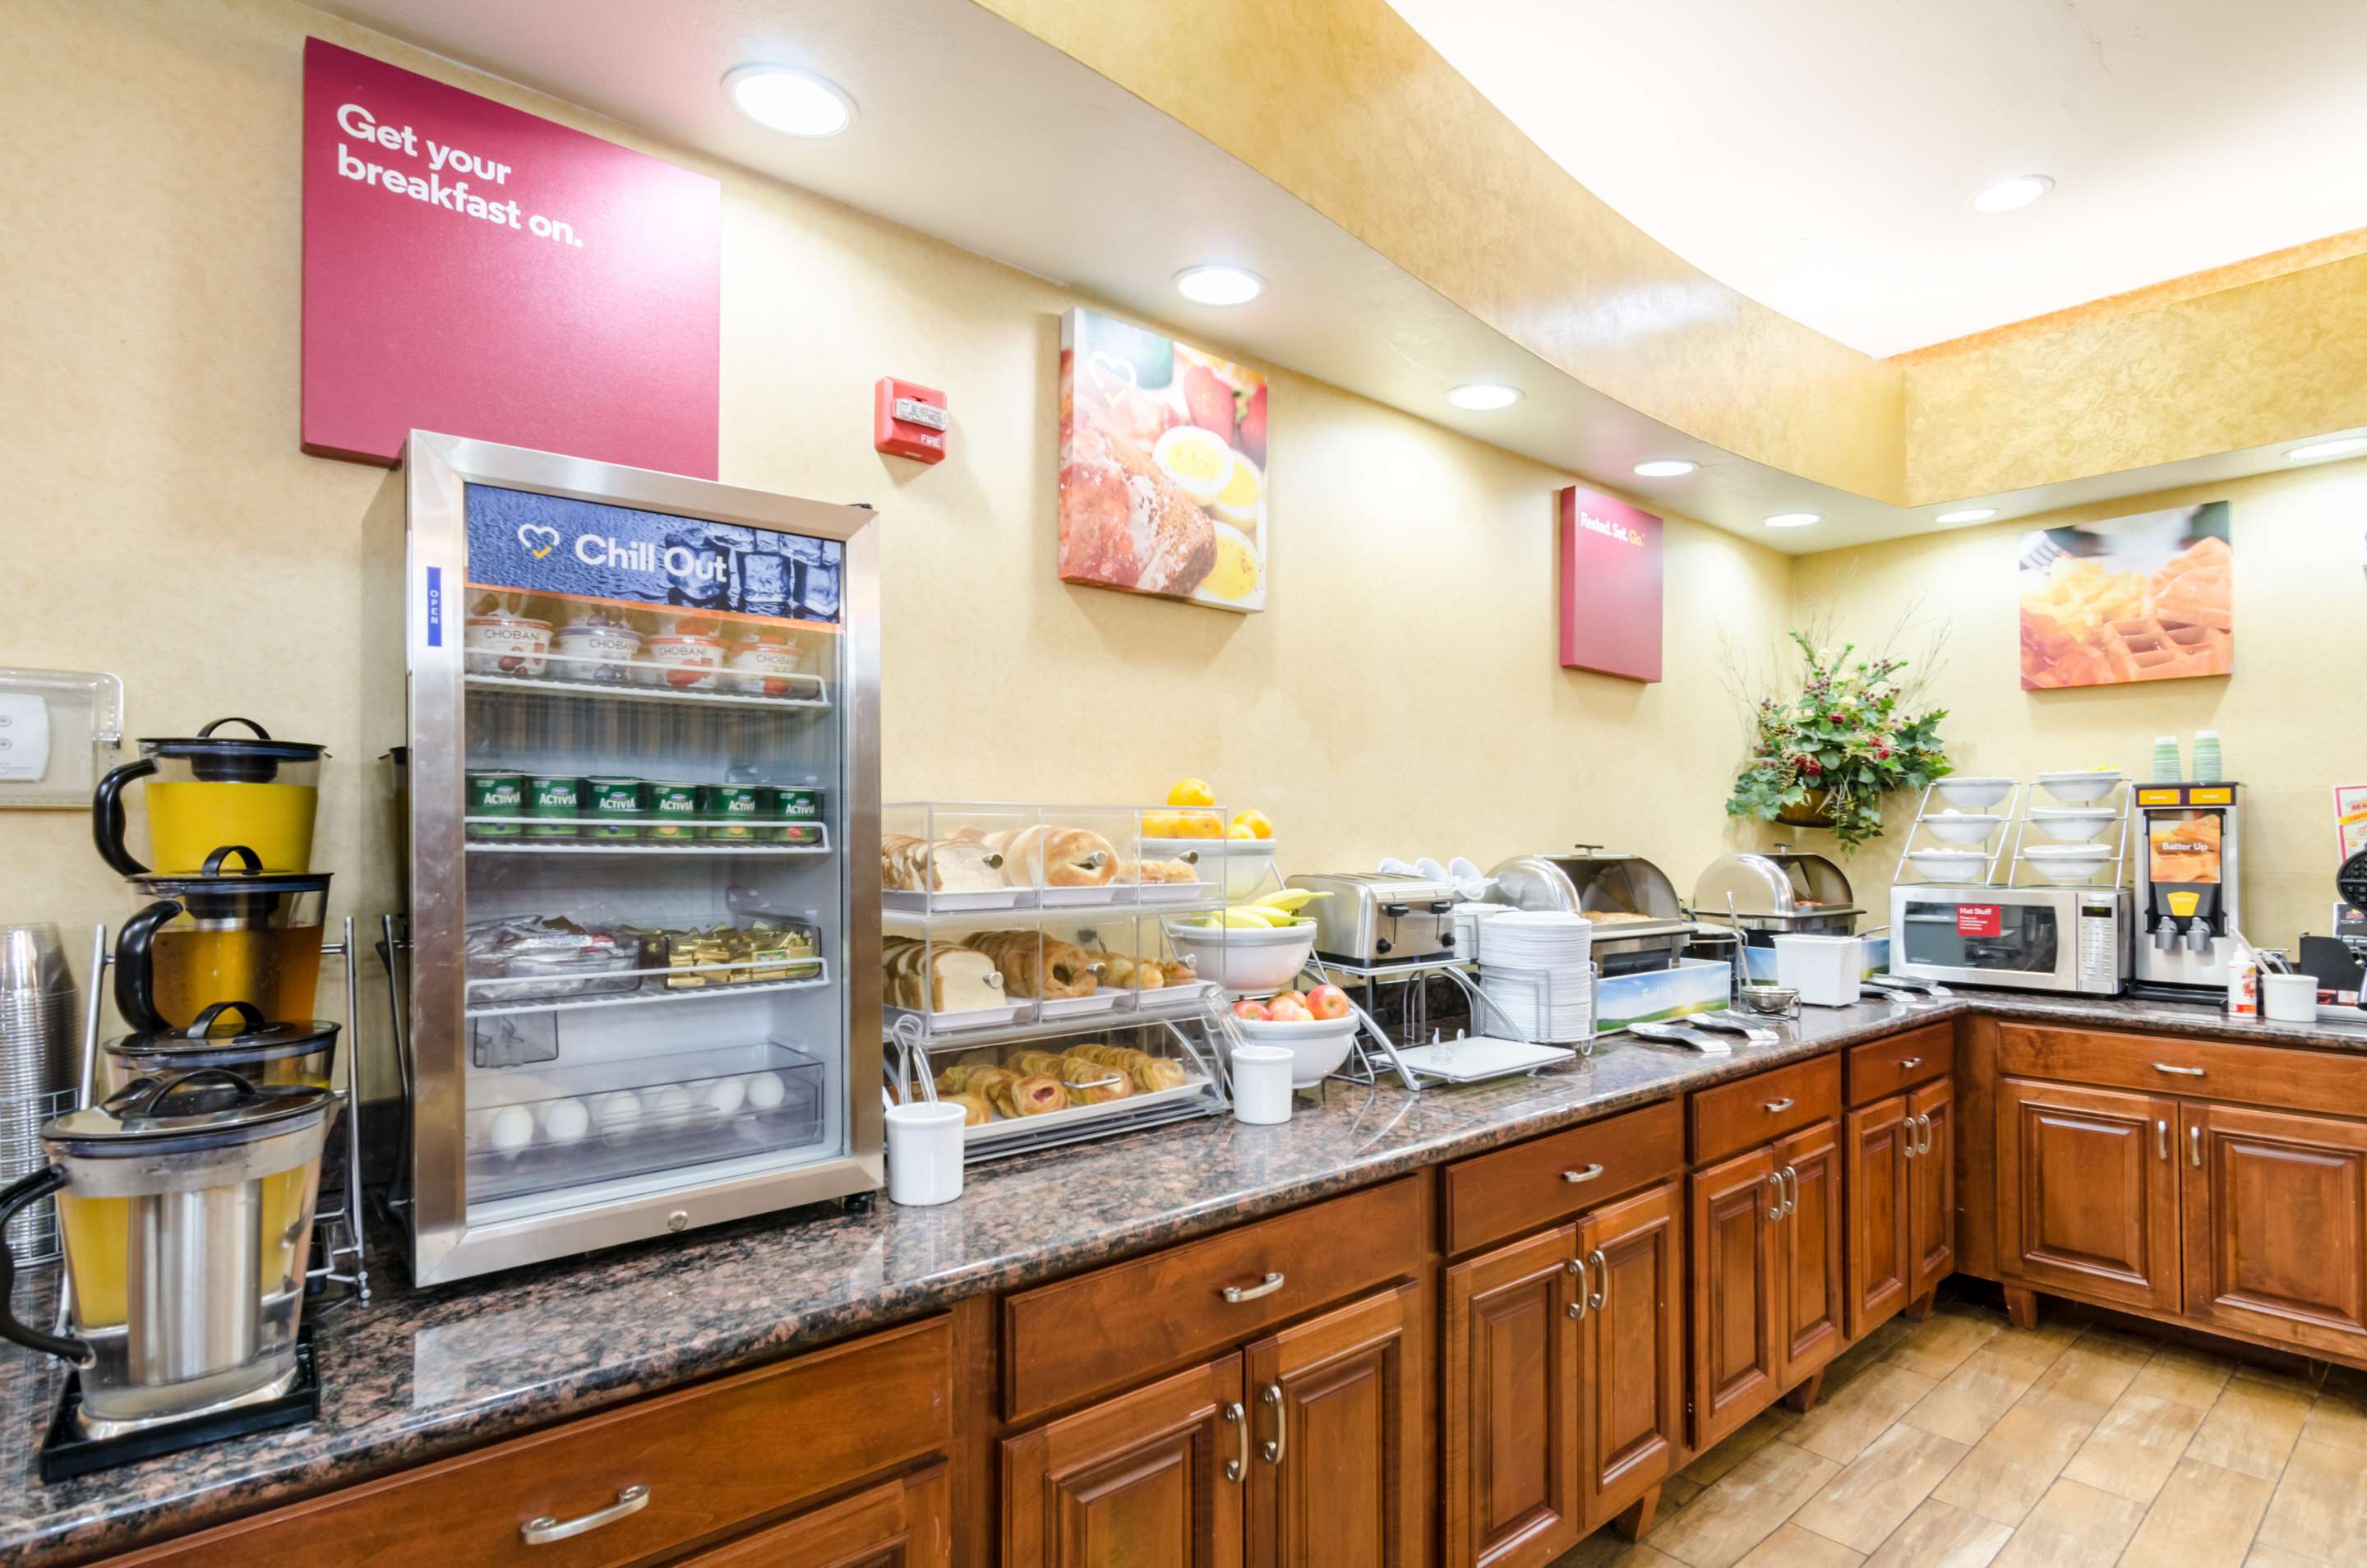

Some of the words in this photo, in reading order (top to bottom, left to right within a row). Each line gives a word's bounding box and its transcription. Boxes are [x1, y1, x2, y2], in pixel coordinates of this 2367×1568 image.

[337, 104, 418, 157] Get
[426, 140, 512, 185] your
[338, 143, 521, 230] breakfast
[528, 214, 583, 247] on.
[920, 433, 941, 448] FIRE
[575, 533, 656, 573] Chill
[663, 546, 728, 583] Out
[429, 589, 440, 625] OPEN
[599, 797, 636, 809] ACTIVIA
[2162, 842, 2192, 851] Batter
[2193, 842, 2209, 852] Up
